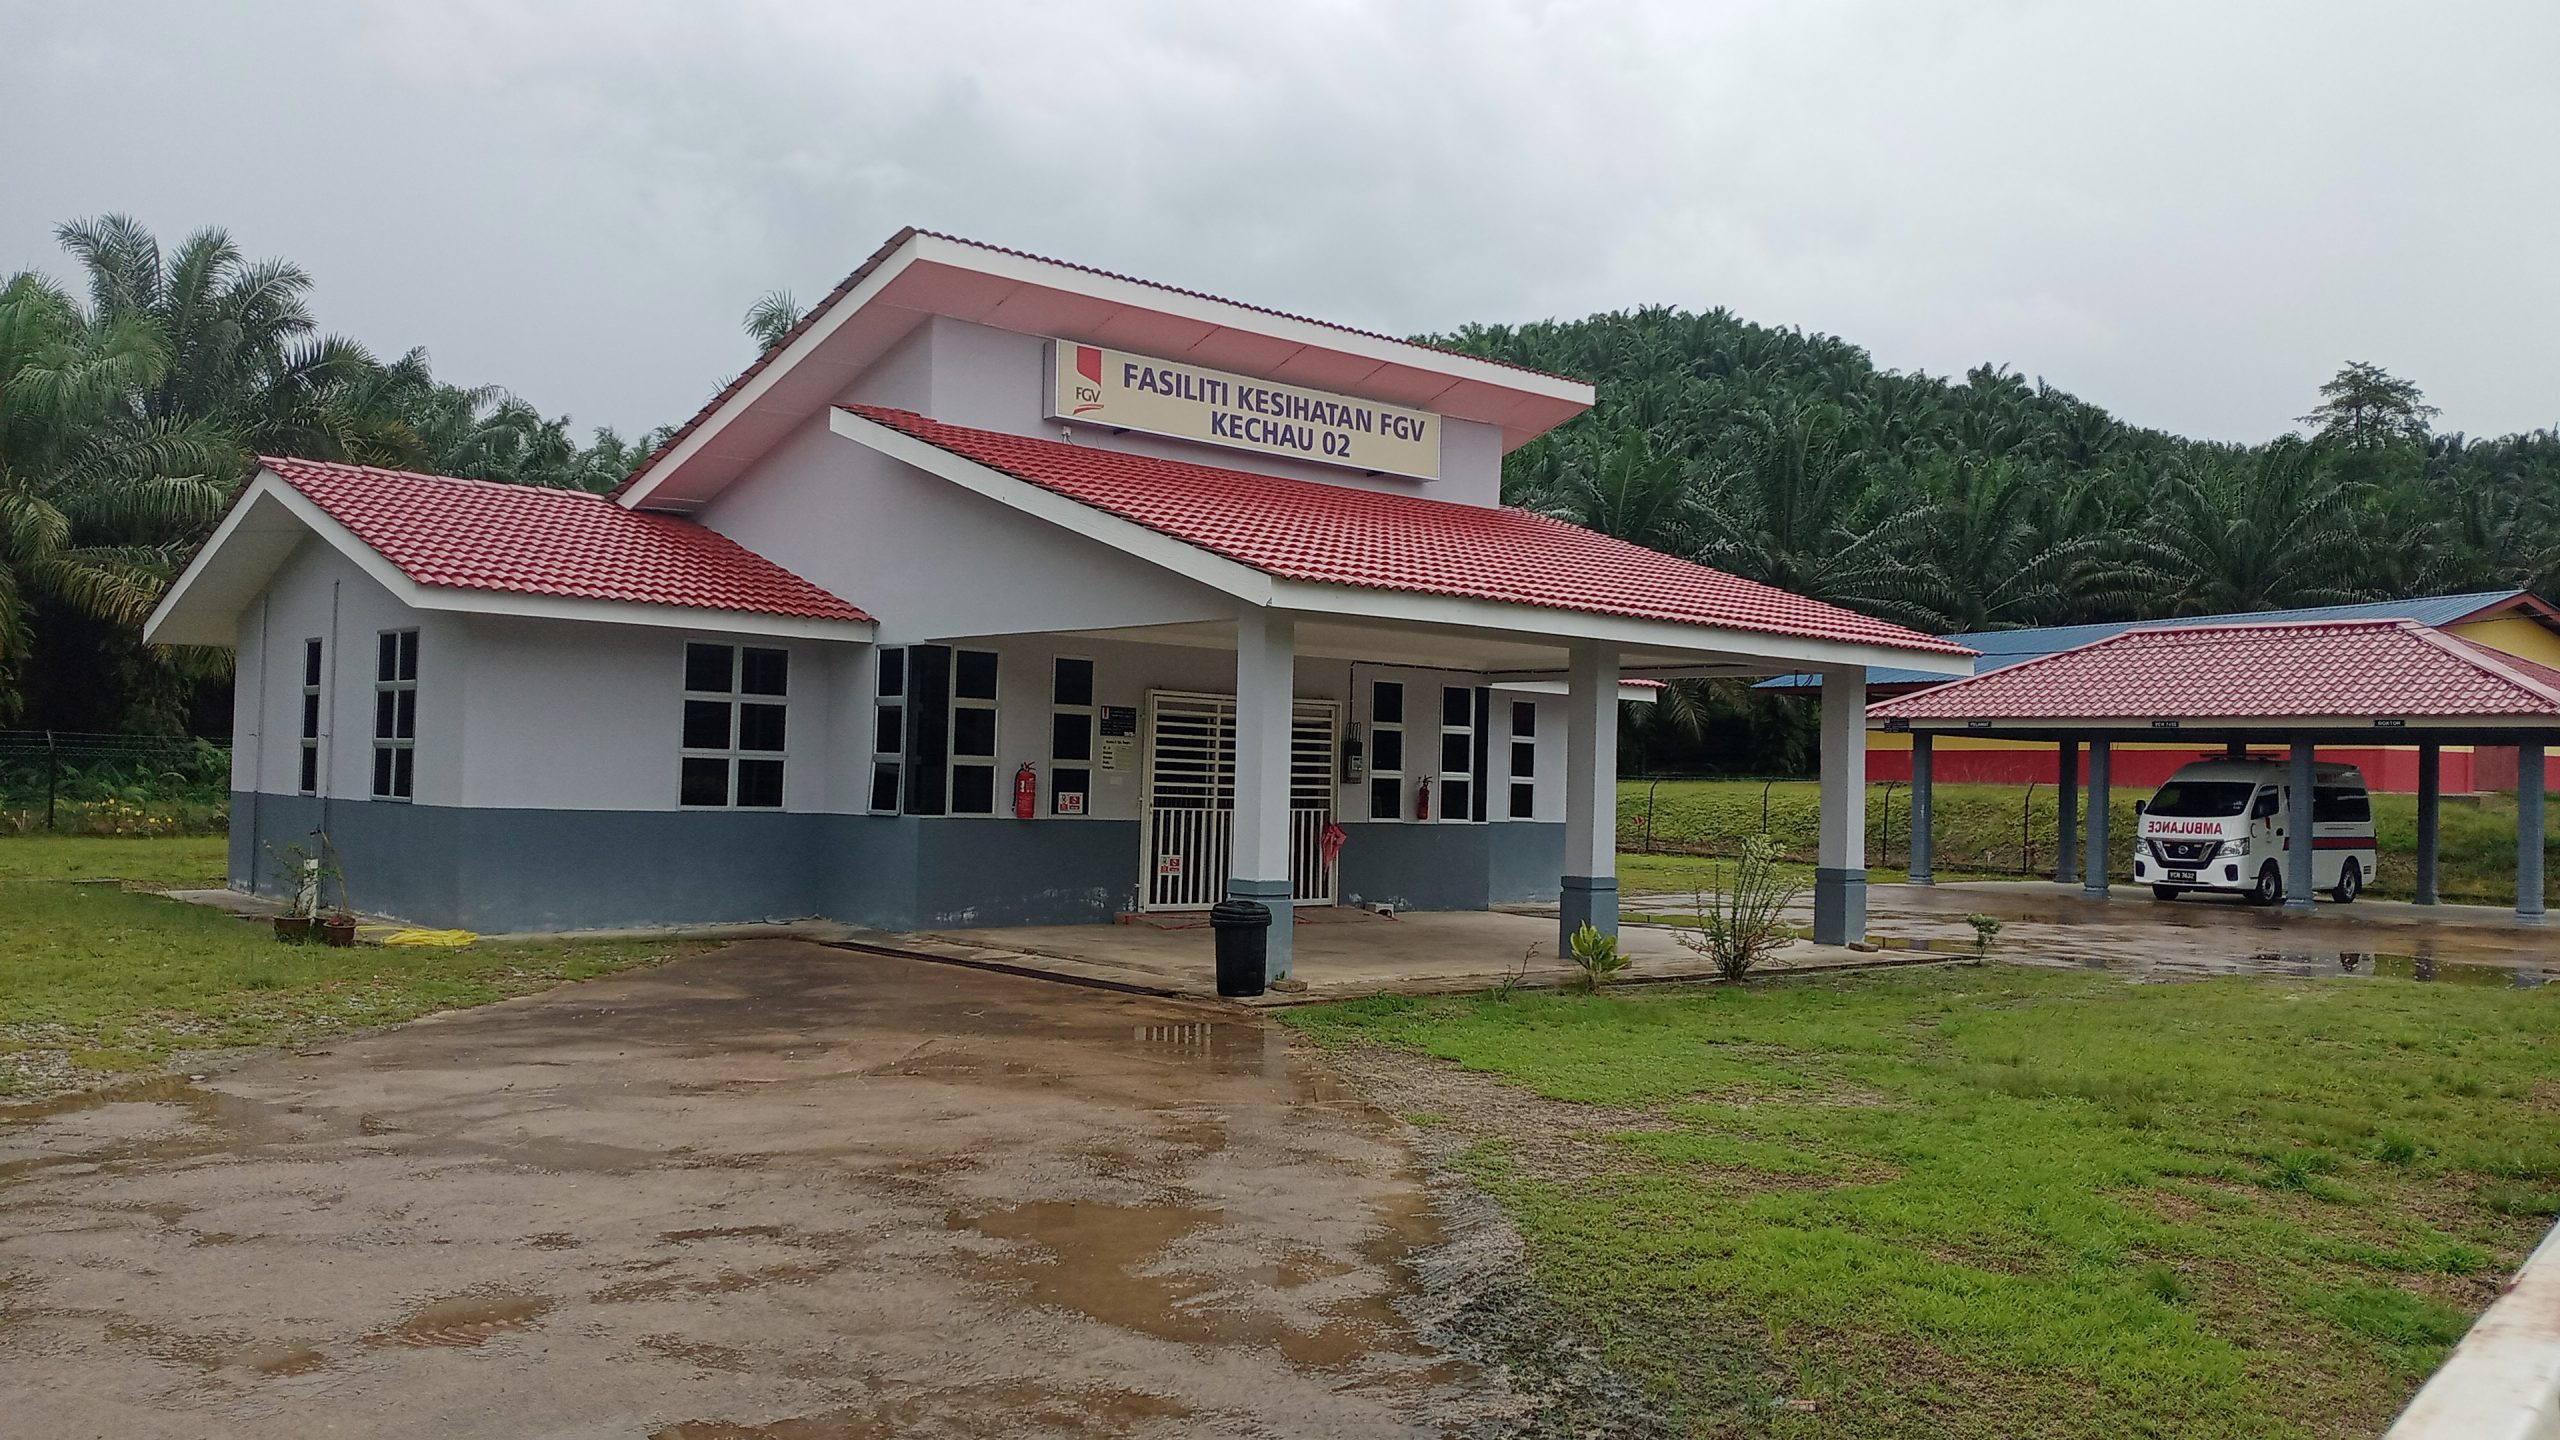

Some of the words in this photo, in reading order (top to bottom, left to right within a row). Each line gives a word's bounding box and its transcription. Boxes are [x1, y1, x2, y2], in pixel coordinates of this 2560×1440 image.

[1075, 386, 1101, 403] FGV
[1123, 363, 1229, 406] FASILITI
[1237, 386, 1373, 433] KESIHATAN
[1380, 412, 1426, 442] FGV
[1211, 410, 1314, 451] KECHAU
[1322, 431, 1351, 458] 02
